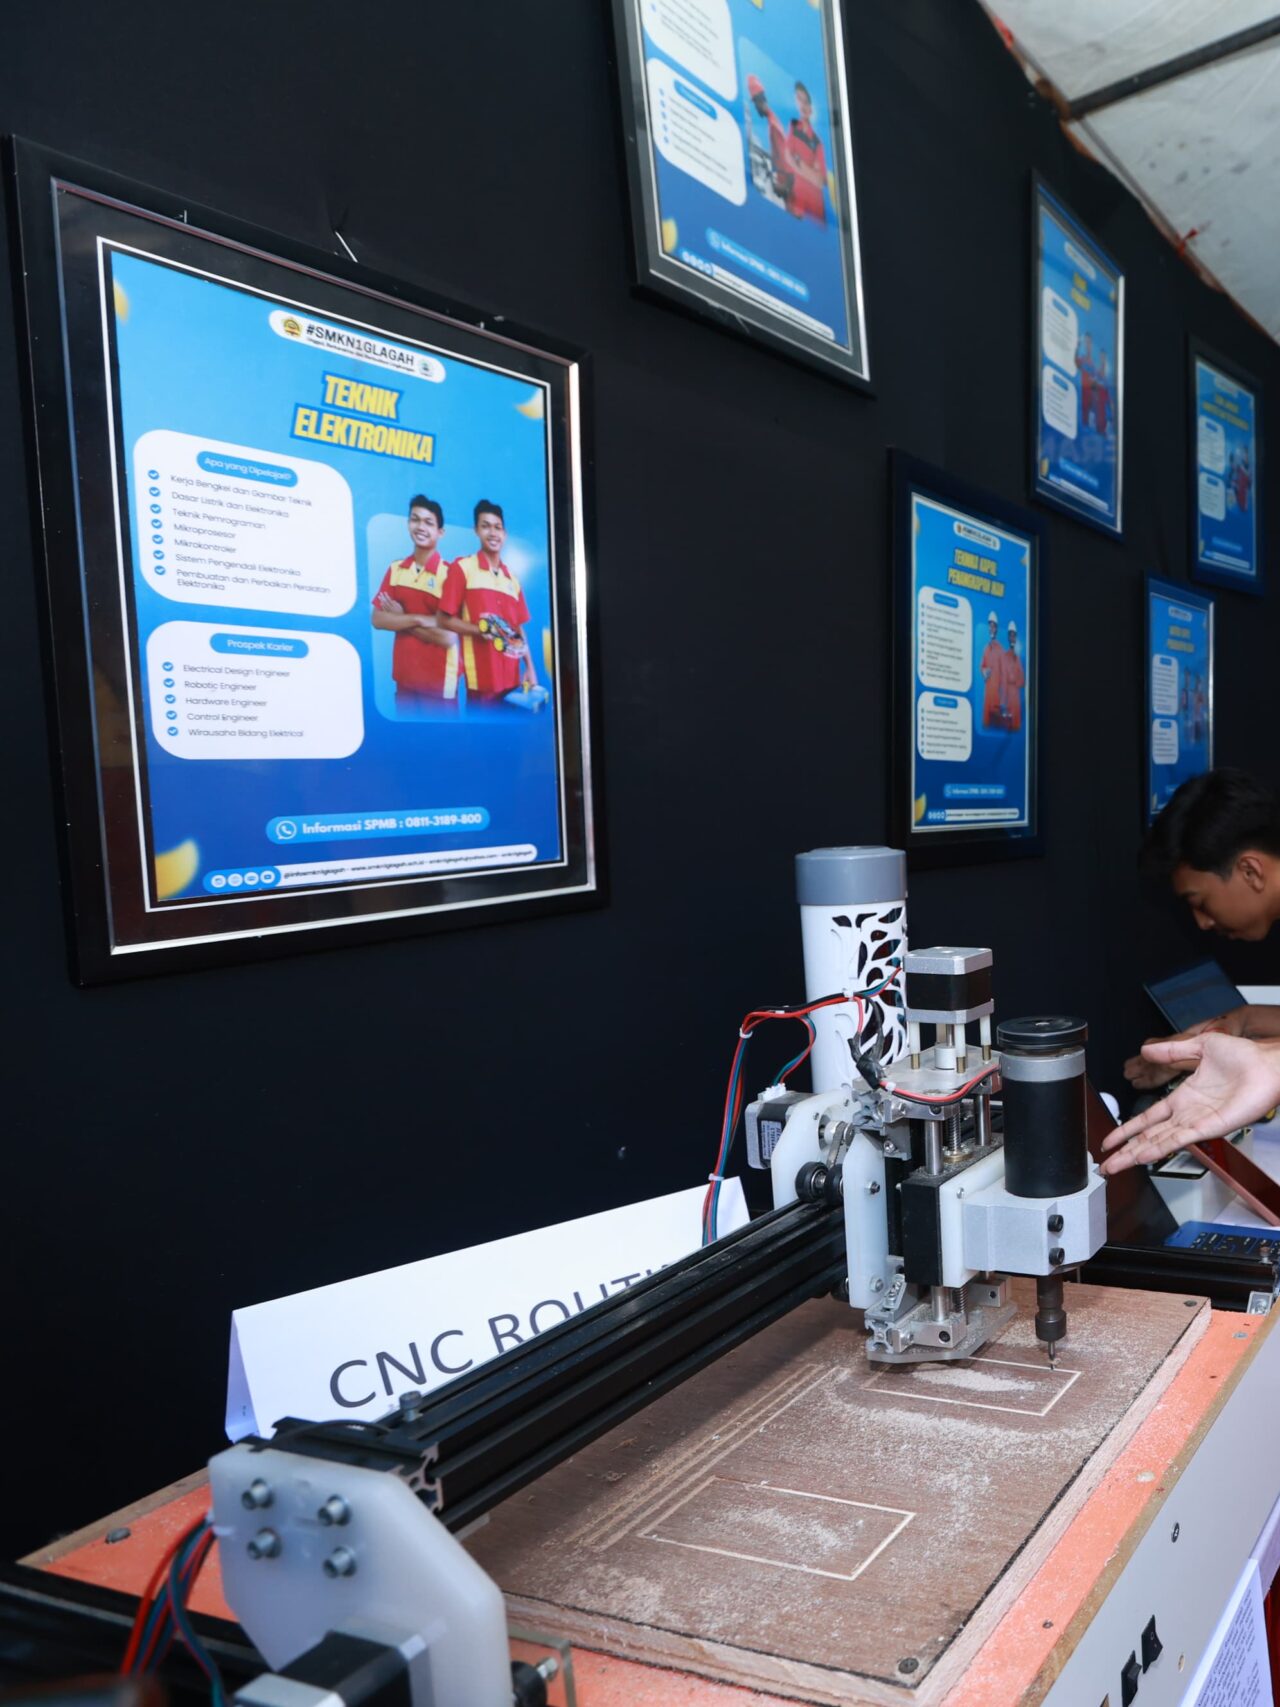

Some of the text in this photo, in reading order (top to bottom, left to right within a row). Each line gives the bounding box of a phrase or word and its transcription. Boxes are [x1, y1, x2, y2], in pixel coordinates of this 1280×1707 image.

[306, 324, 415, 366] #SMKN1GLAGAH
[324, 374, 400, 419] TEKNIK
[293, 406, 435, 463] ELEKTRONIKA
[170, 475, 312, 507] Kerja Bengkel dan Gambar Teknik
[171, 491, 199, 503] Dasar
[226, 500, 243, 510] dan
[172, 508, 201, 520] Teknik
[173, 523, 236, 539] Mikroprosesor
[175, 553, 207, 565] Sistem
[176, 569, 230, 582] Pembuatan
[231, 575, 249, 585] dan
[226, 639, 265, 652] Prospek
[183, 664, 290, 679] Electrical Design Engineer
[220, 682, 257, 693] Engineer
[185, 696, 267, 709] Hardware Engineer
[187, 712, 258, 724] Control Engineer
[188, 728, 236, 737] Wirausaha
[238, 729, 268, 739] Bidang
[302, 820, 362, 835] Informasi
[364, 818, 397, 831] SPMB
[329, 1329, 475, 1409] CNC
